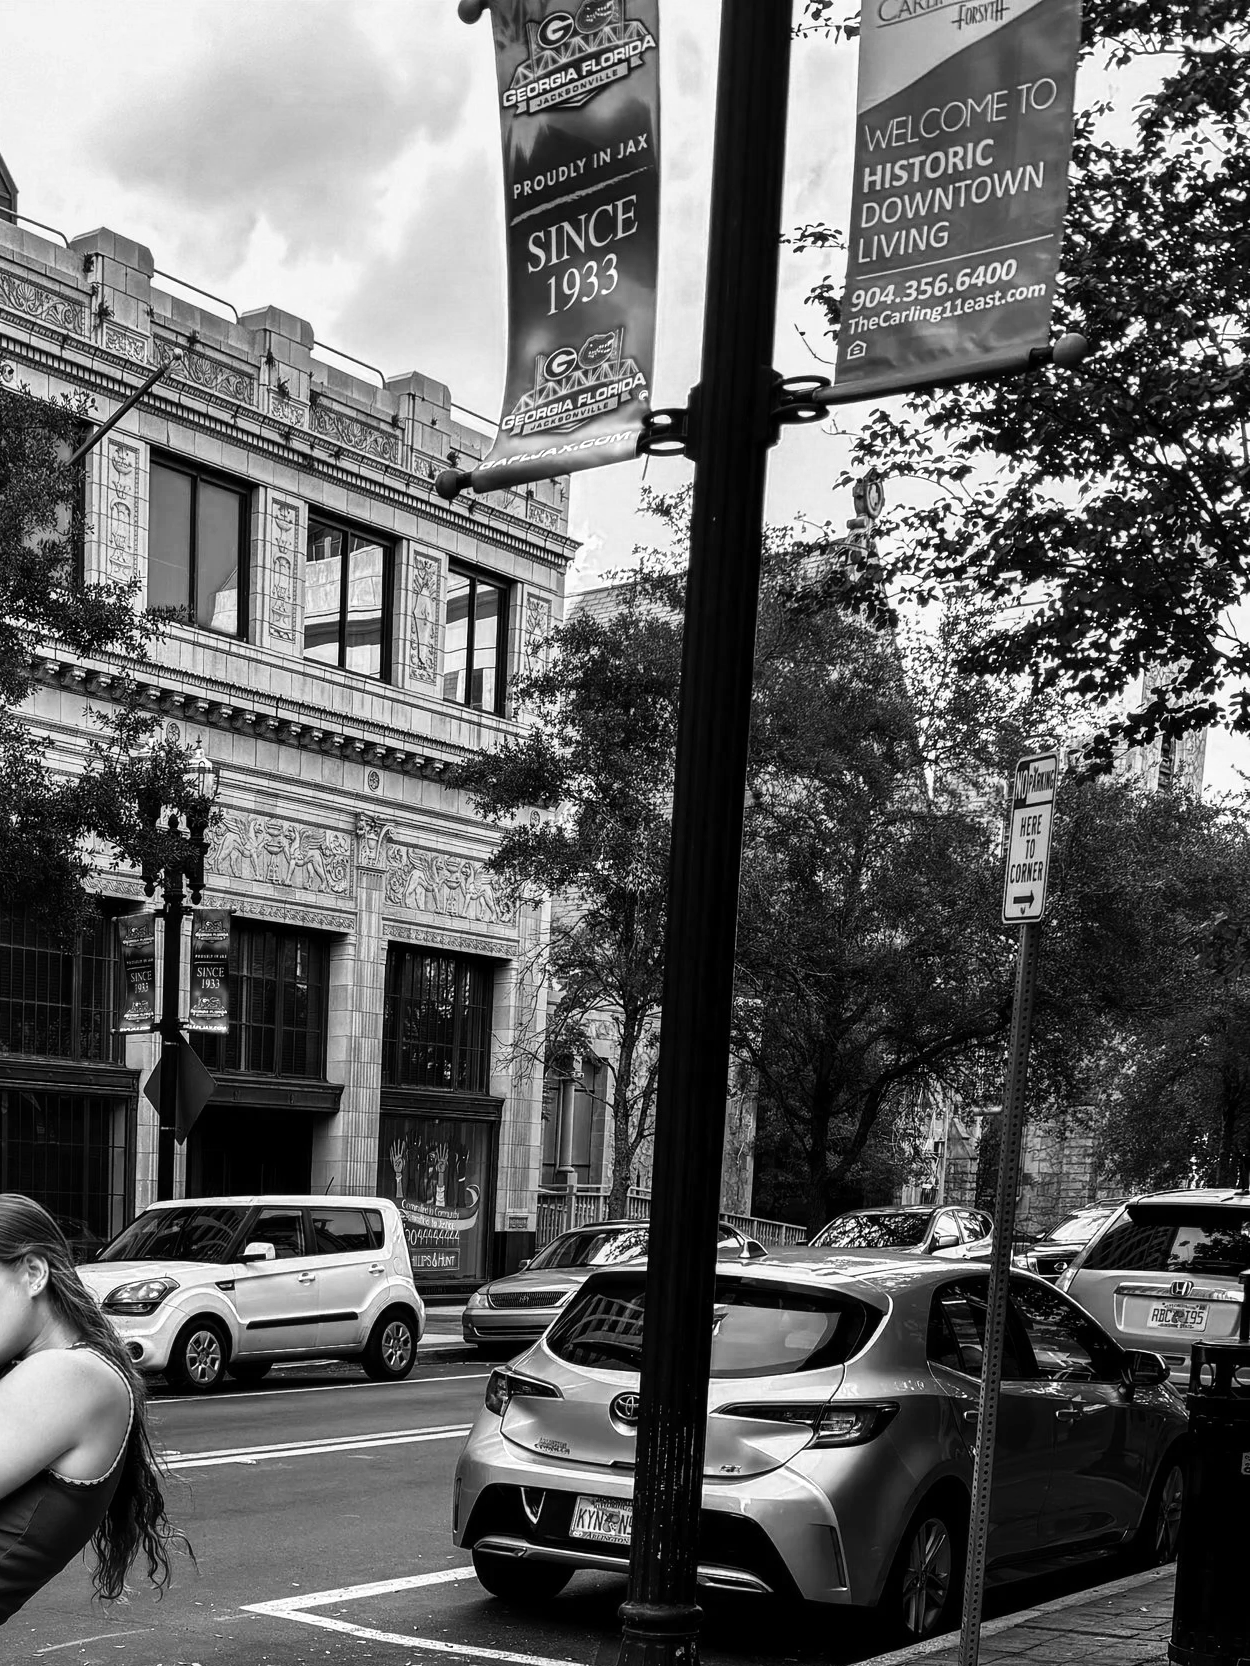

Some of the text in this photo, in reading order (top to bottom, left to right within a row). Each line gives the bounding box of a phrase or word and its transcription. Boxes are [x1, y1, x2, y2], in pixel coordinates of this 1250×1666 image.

[951, 0, 1010, 30] FORSYTH
[503, 34, 656, 107] GEORGIA FLORIDA
[537, 69, 619, 107] JACKSONVILLE
[865, 78, 1057, 151] WELCOME TO
[513, 133, 648, 199] PROUDLY IN JAX
[863, 139, 994, 193] HISTORIC
[861, 161, 1045, 228] DOWNTOWN
[527, 195, 638, 274] SINCE
[858, 222, 950, 263] LIVING
[547, 253, 619, 316] 1933
[850, 258, 1018, 312] 904.356.6400
[848, 283, 1047, 335] TheCarling11east.com
[501, 372, 646, 430] GEORGIA FLORIDA
[530, 402, 609, 431] JACKSONVILLE
[1015, 769, 1055, 800] NO PARKING
[1020, 814, 1043, 837] HERE
[1025, 838, 1036, 859] TO
[1010, 861, 1044, 883] CORNER
[130, 970, 152, 982] SINCE
[197, 967, 225, 977] SINCE
[201, 979, 220, 989] 1933
[134, 982, 149, 993] 1933
[411, 1255, 432, 1267] HILLIPS
[1151, 1308, 1172, 1323] RBC
[577, 1508, 605, 1531] KYN
[584, 1532, 630, 1544] ARLINGTON
